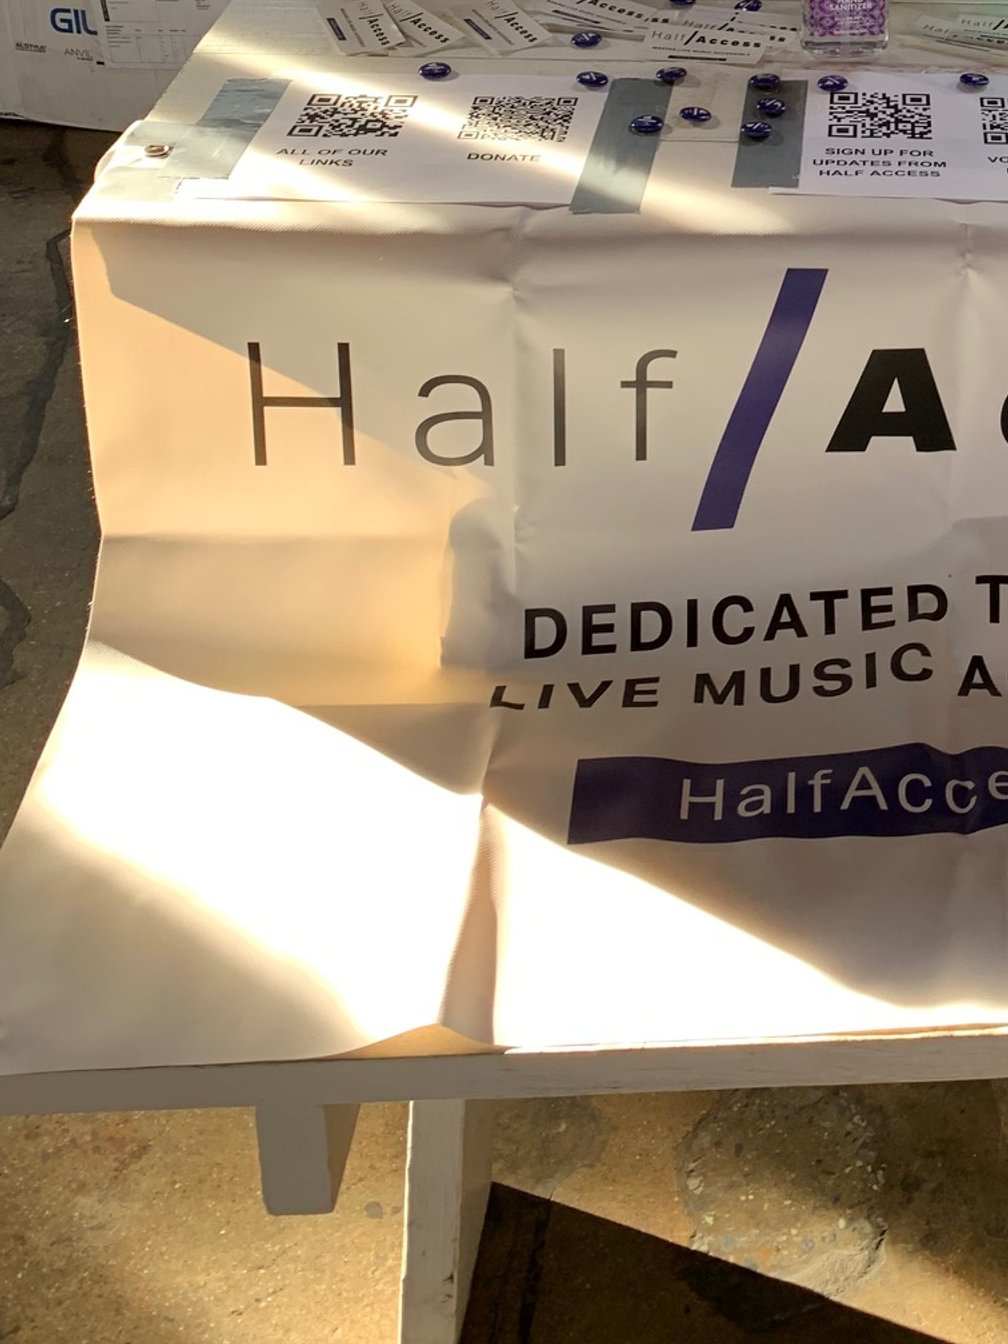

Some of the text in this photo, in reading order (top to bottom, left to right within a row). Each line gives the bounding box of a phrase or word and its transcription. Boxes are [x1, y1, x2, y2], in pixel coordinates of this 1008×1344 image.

[276, 148, 389, 156] ALL OF OUR
[825, 148, 934, 158] SIGN UP FOR
[466, 152, 541, 163] DONATE
[298, 159, 354, 167] LINKS
[812, 159, 947, 168] UPDATES FROM
[818, 170, 941, 178] HALF ACCESS
[523, 583, 949, 660] DEDICATED
[489, 675, 661, 711] LIVE
[692, 642, 934, 707] MUSIC
